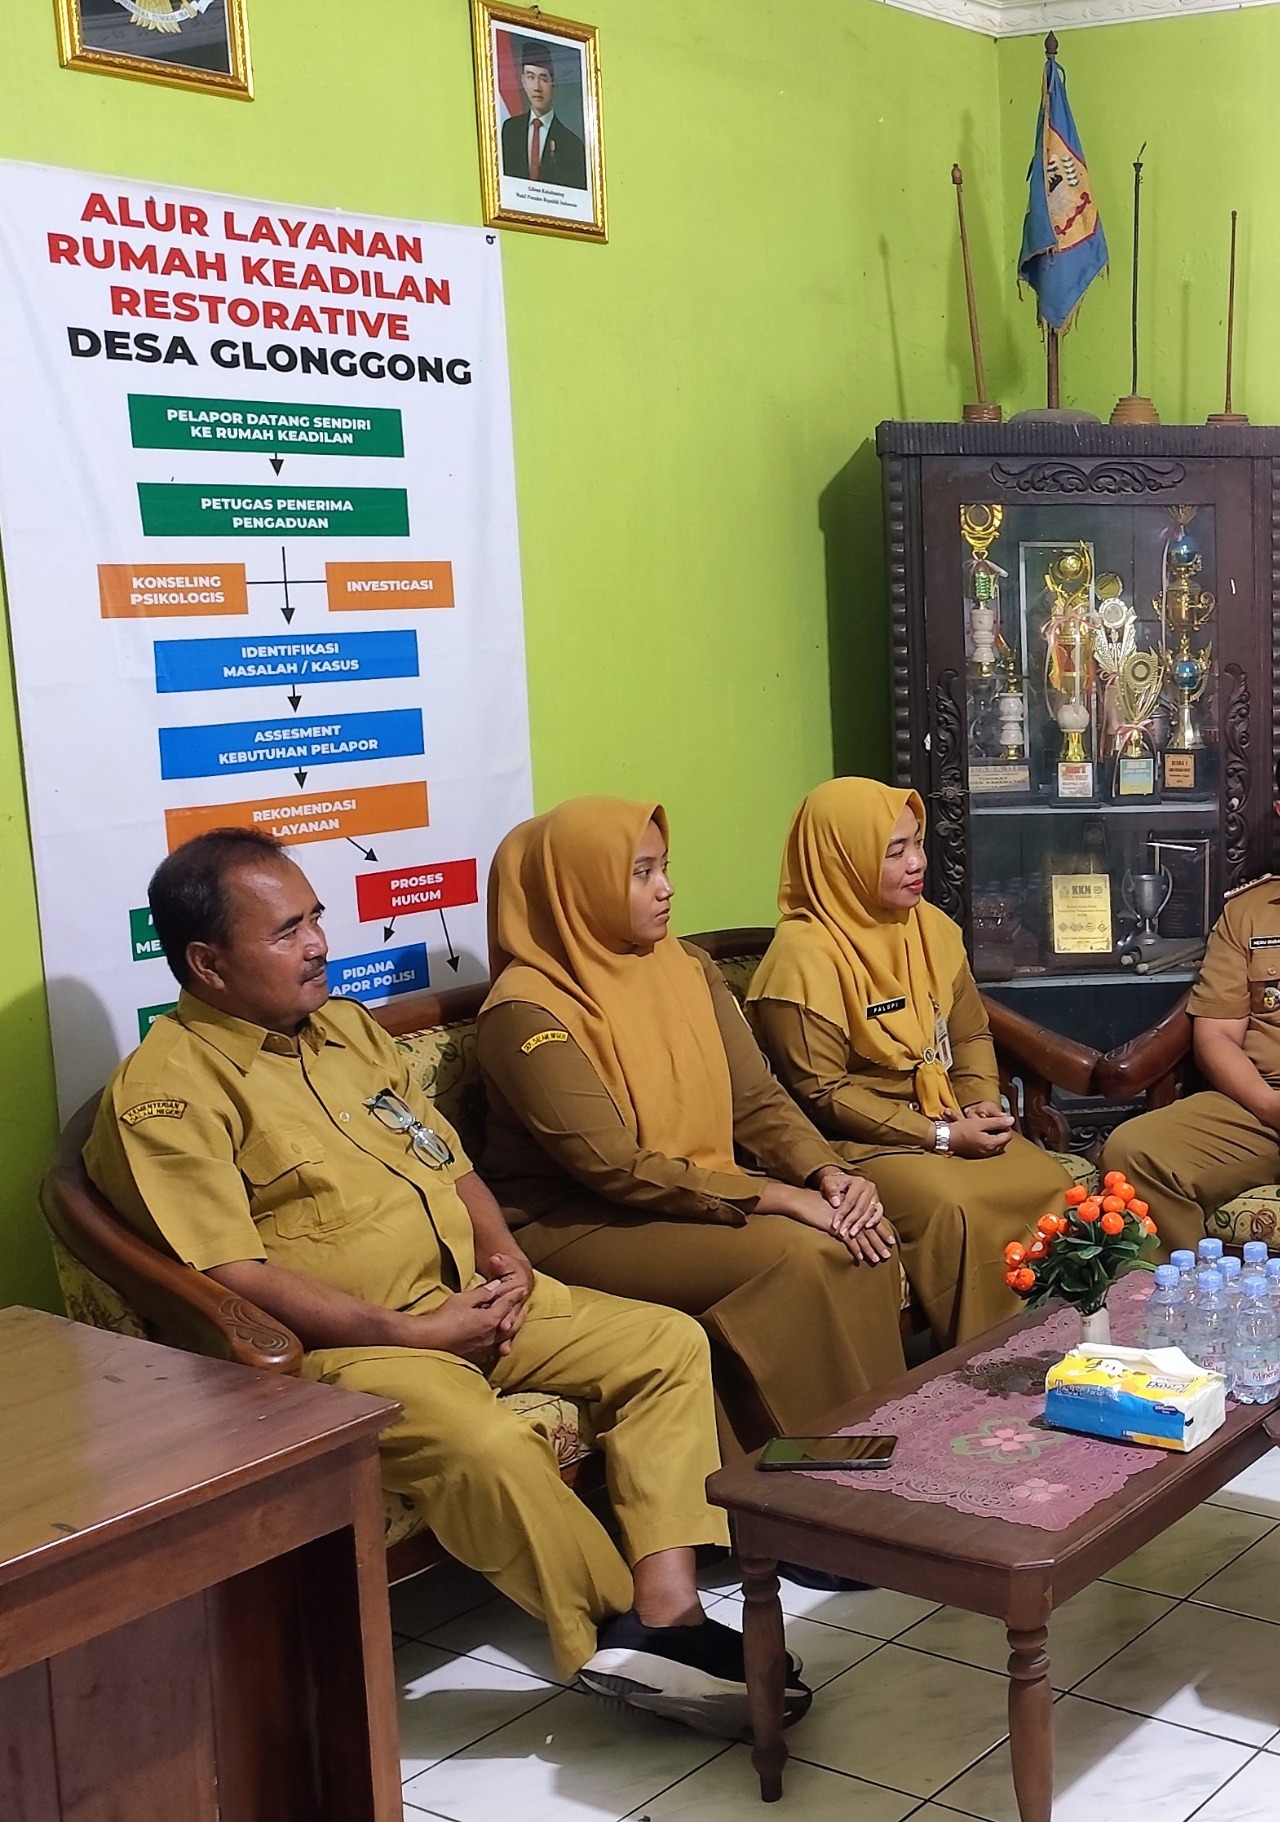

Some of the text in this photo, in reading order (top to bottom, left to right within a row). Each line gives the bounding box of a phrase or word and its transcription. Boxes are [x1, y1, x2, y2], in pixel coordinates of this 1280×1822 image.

[80, 192, 423, 263] ALUR LAYANAN
[47, 232, 451, 305] RUMAH KEADILAN
[109, 286, 410, 341] RESTORATIVE
[66, 326, 472, 385] DESA GLONGGONG
[167, 409, 371, 430] PELAPOR DATANG SENDIRI
[191, 426, 353, 444] KE RUMAH KEADILAN
[201, 497, 353, 511] PETUGAS PENERIMA
[232, 517, 328, 529] PENGADUAN
[132, 575, 221, 589] KONSELING
[347, 579, 433, 592] INVESTIGASI
[130, 591, 224, 605] PSIKOLOGIS
[241, 642, 339, 658] IDENTIFIKASI
[223, 659, 359, 678] MASALAH / KASUS
[254, 725, 341, 743] ASSESMENT
[218, 739, 378, 764] KEBUTUHAN PELAPOR
[253, 800, 357, 822] REKOMENDASI
[272, 818, 339, 837] LAYANAN
[390, 873, 444, 890] PROSES
[1072, 885, 1091, 895] KKN
[392, 889, 441, 907] HUKUM
[343, 960, 395, 979] PIDANA
[374, 970, 415, 988] POLISI
[873, 1002, 899, 1013] PALUPI
[127, 1101, 179, 1118] KEMENTERIAN
